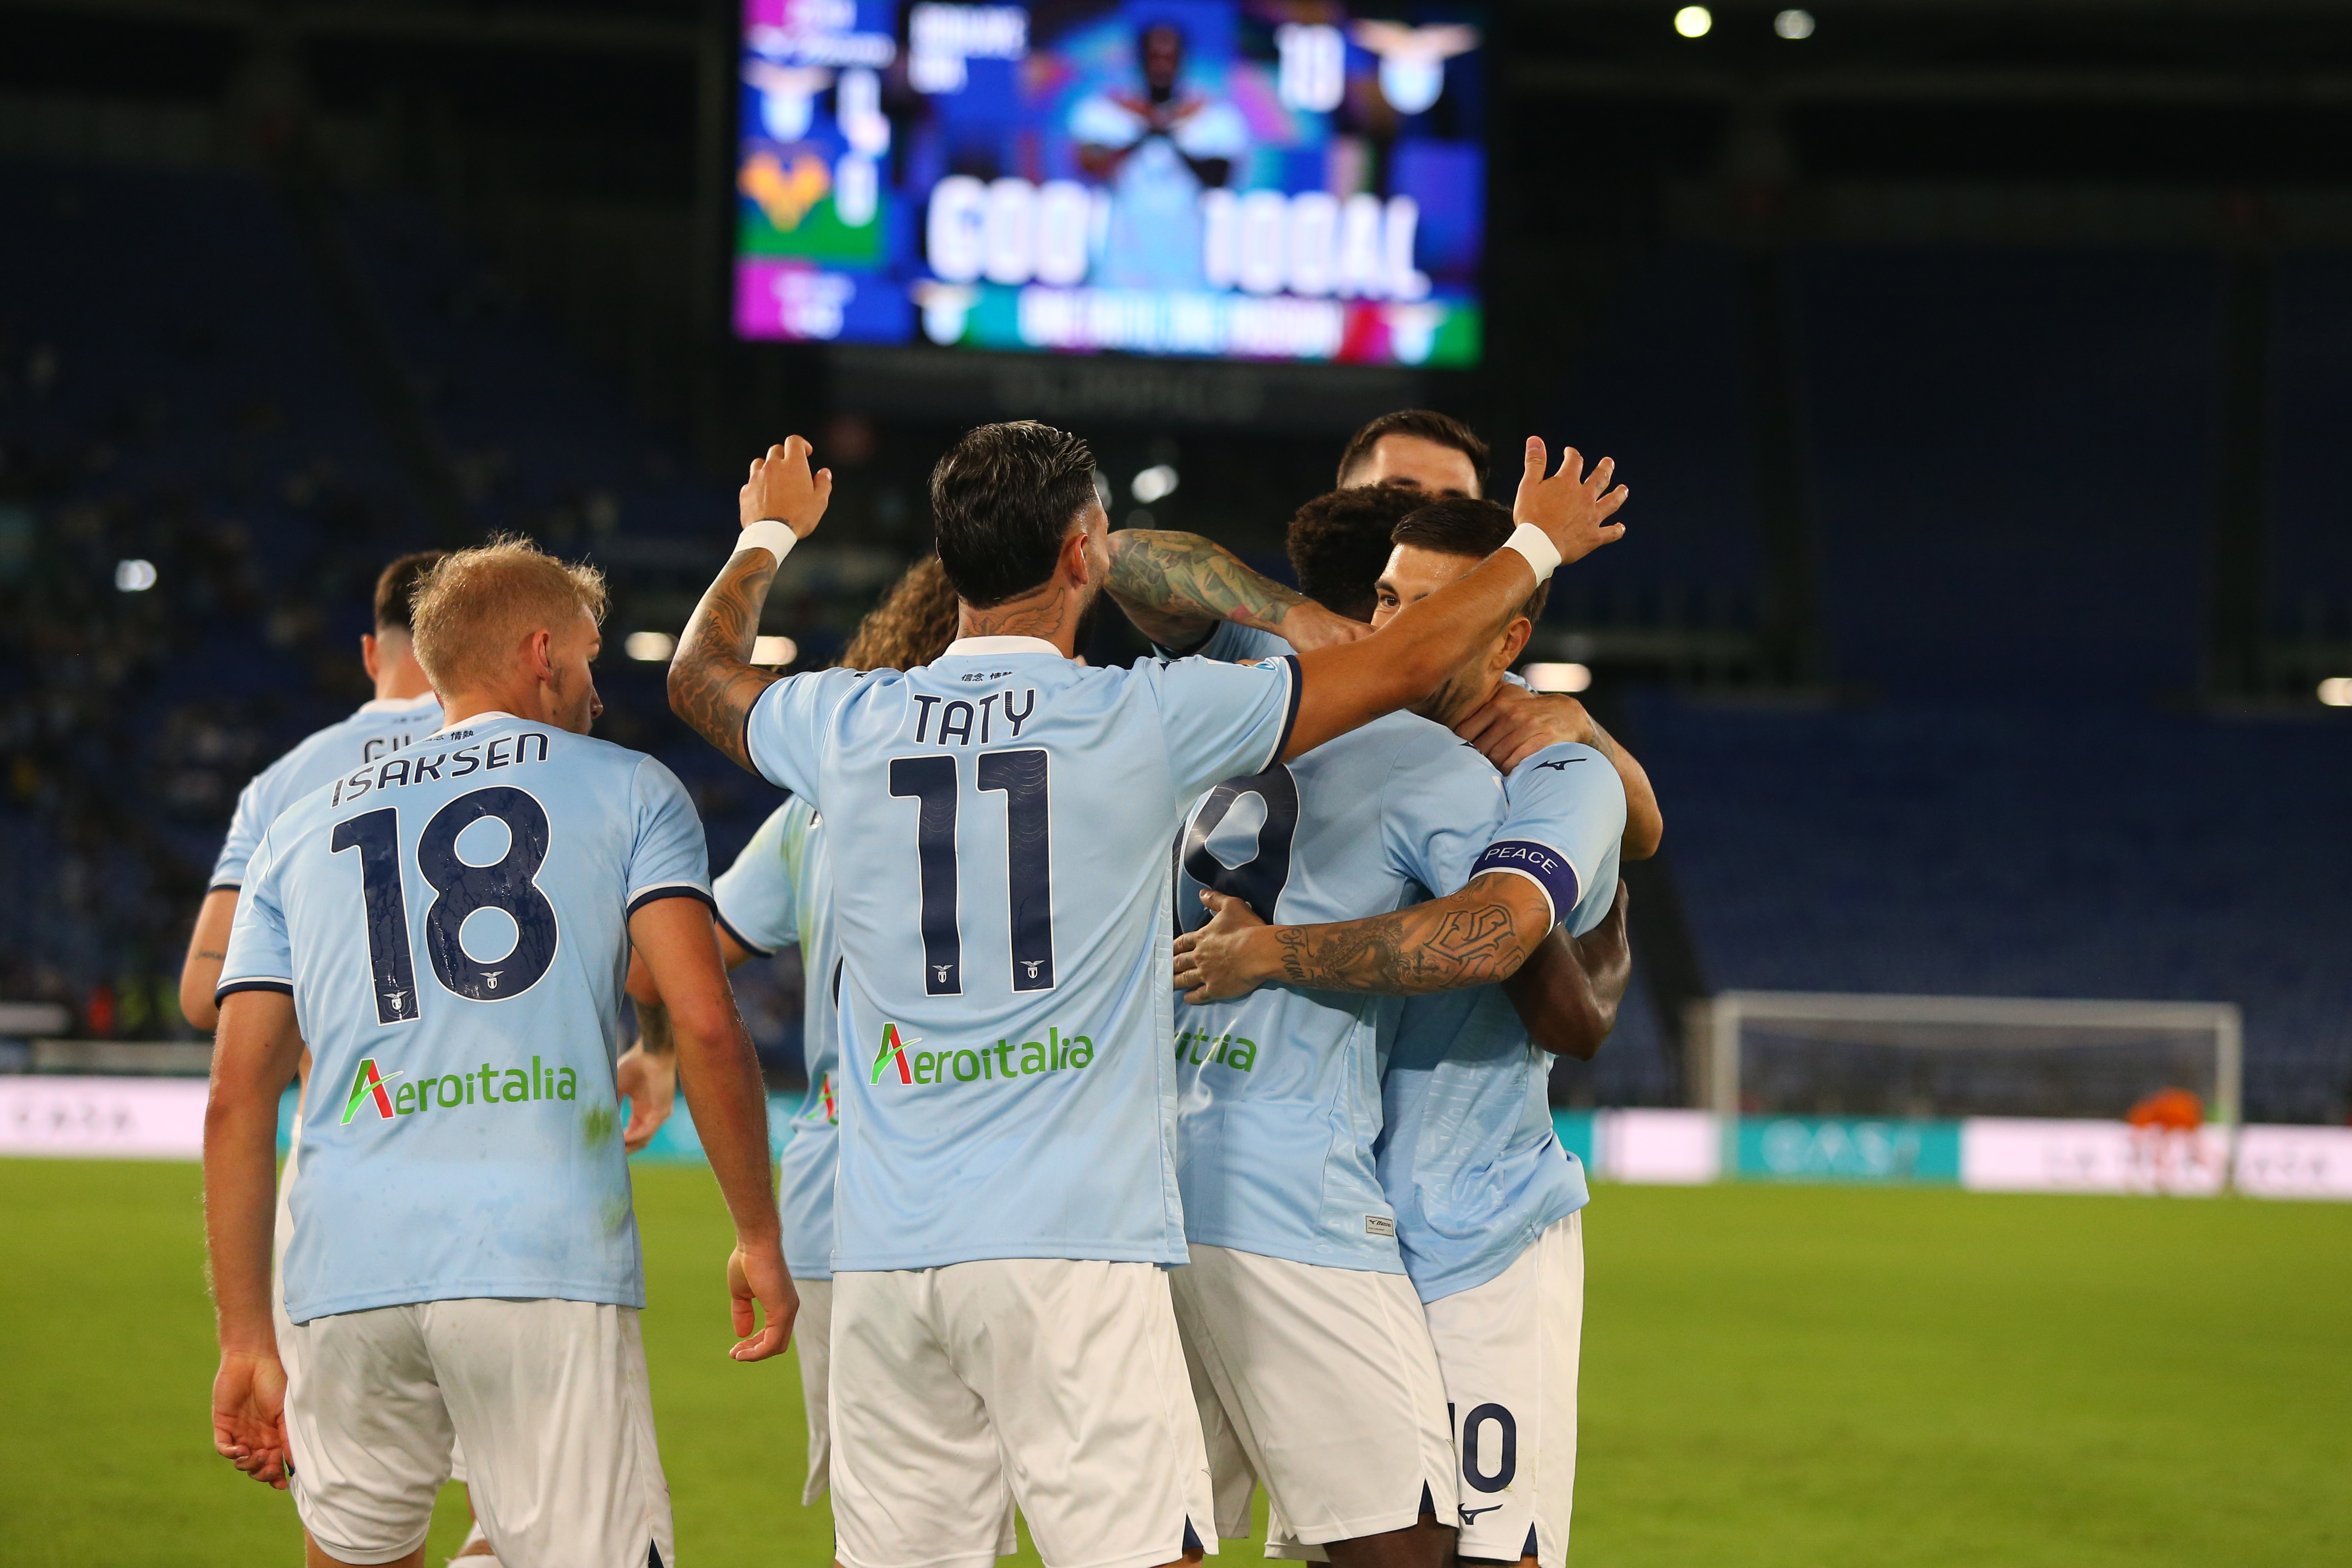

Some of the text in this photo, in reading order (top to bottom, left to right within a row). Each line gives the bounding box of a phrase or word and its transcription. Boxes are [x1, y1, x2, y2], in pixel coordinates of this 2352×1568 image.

[912, 688, 1036, 747] TATY
[329, 732, 550, 809] ISAKSEN
[888, 746, 1057, 997] 11
[1484, 846, 1558, 875] PEACE
[329, 784, 560, 1027] 18
[339, 1055, 577, 1126] Aeroitalia
[869, 1021, 1094, 1086] Aeroitalia
[1447, 1402, 1517, 1494] 0
